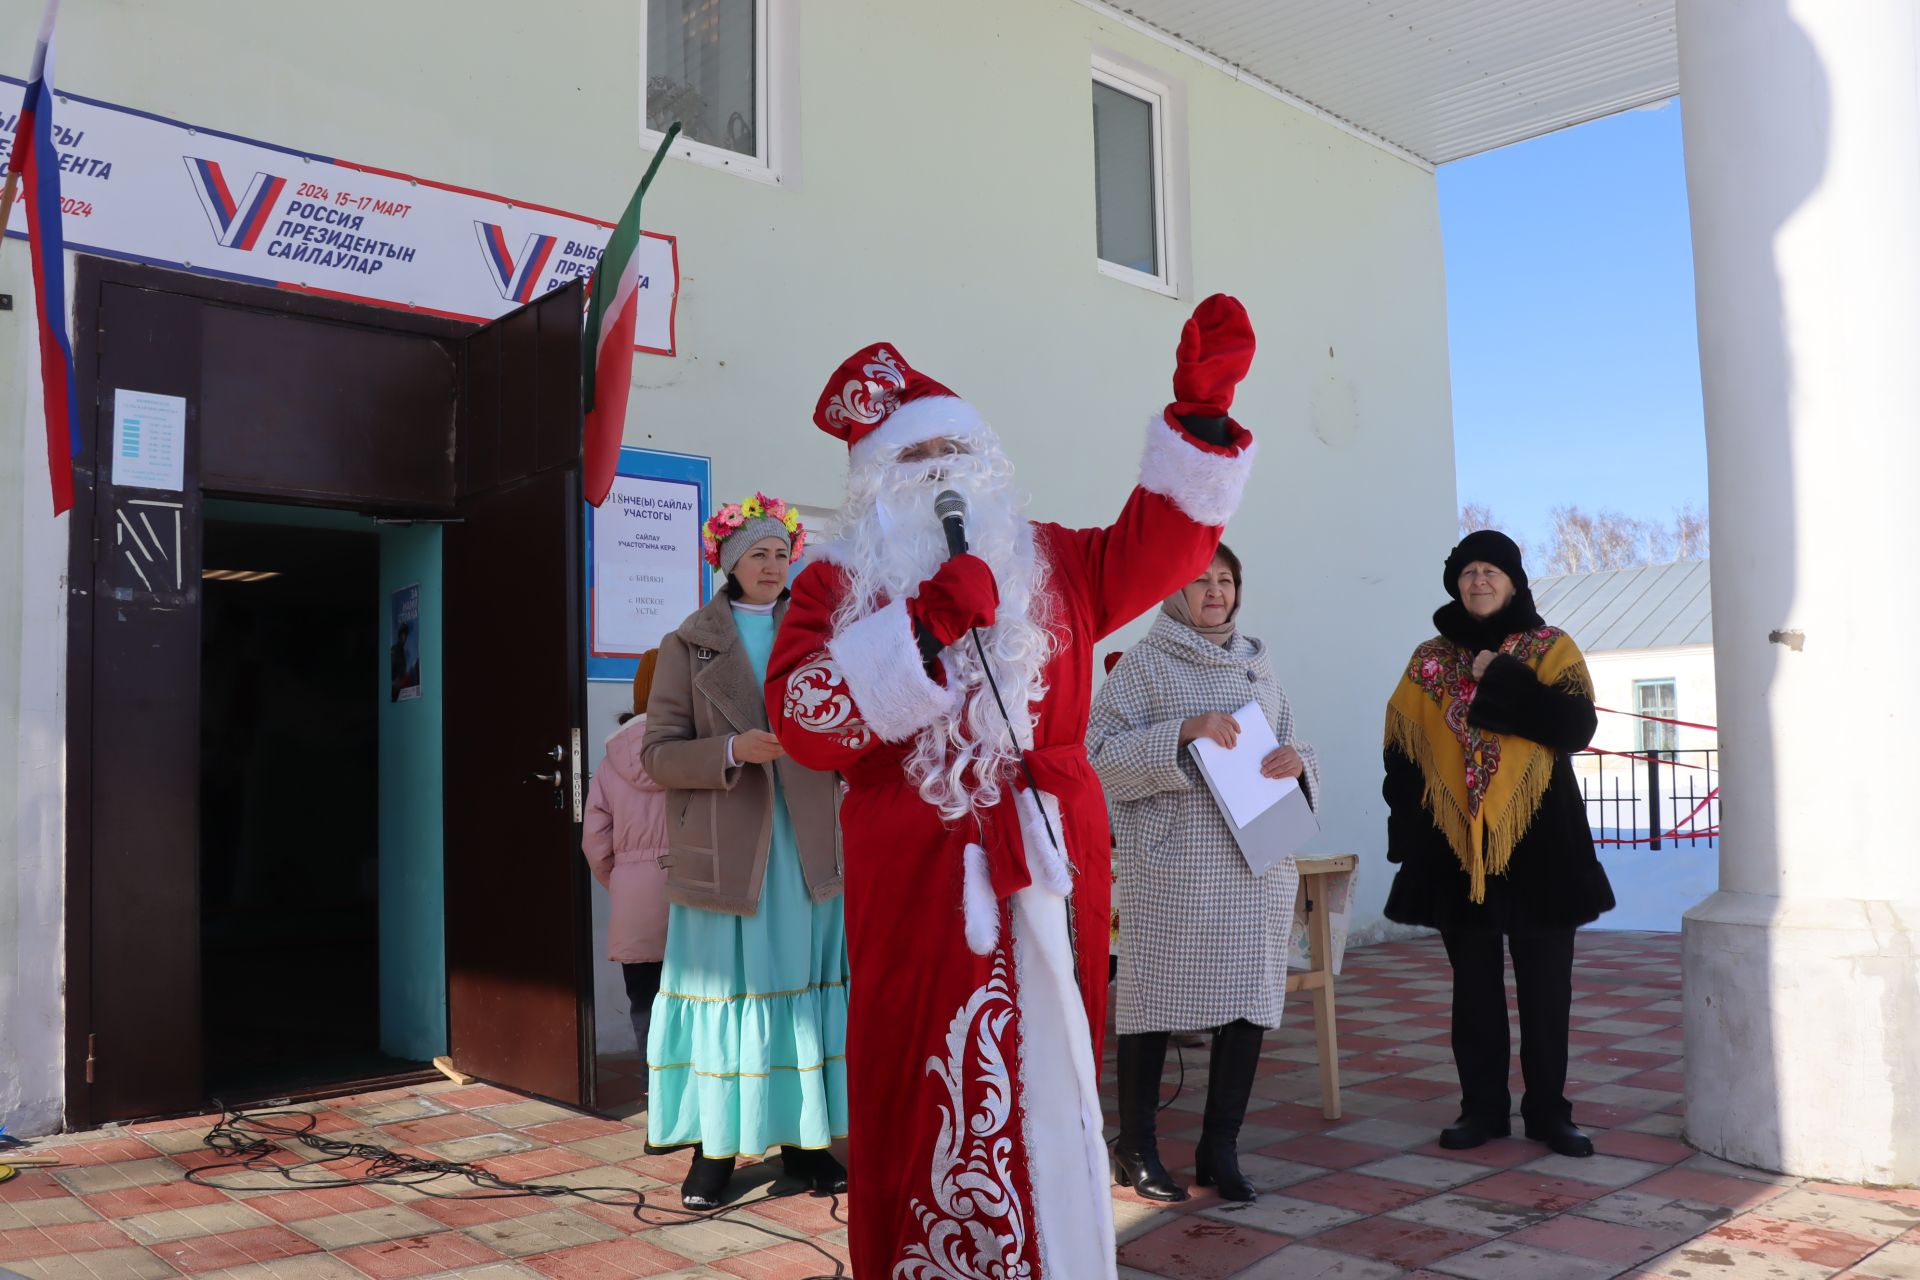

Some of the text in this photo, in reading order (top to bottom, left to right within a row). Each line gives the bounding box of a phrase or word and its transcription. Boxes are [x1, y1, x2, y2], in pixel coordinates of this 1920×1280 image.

[296, 182, 329, 201] 2024
[372, 199, 412, 218] МАРТ
[286, 200, 364, 231] РОССИЯ
[276, 220, 416, 263] ПРЕЗИДЕНТЫН
[563, 240, 605, 262] ВЫБО
[267, 240, 383, 275] САЙЛАУЛАР
[623, 508, 672, 521] УЧАСТОГЫ
[657, 499, 693, 511] САЙЛАУ
[618, 540, 659, 550] УЧАСТОГЫНА
[635, 533, 660, 541] САЙЛАУ
